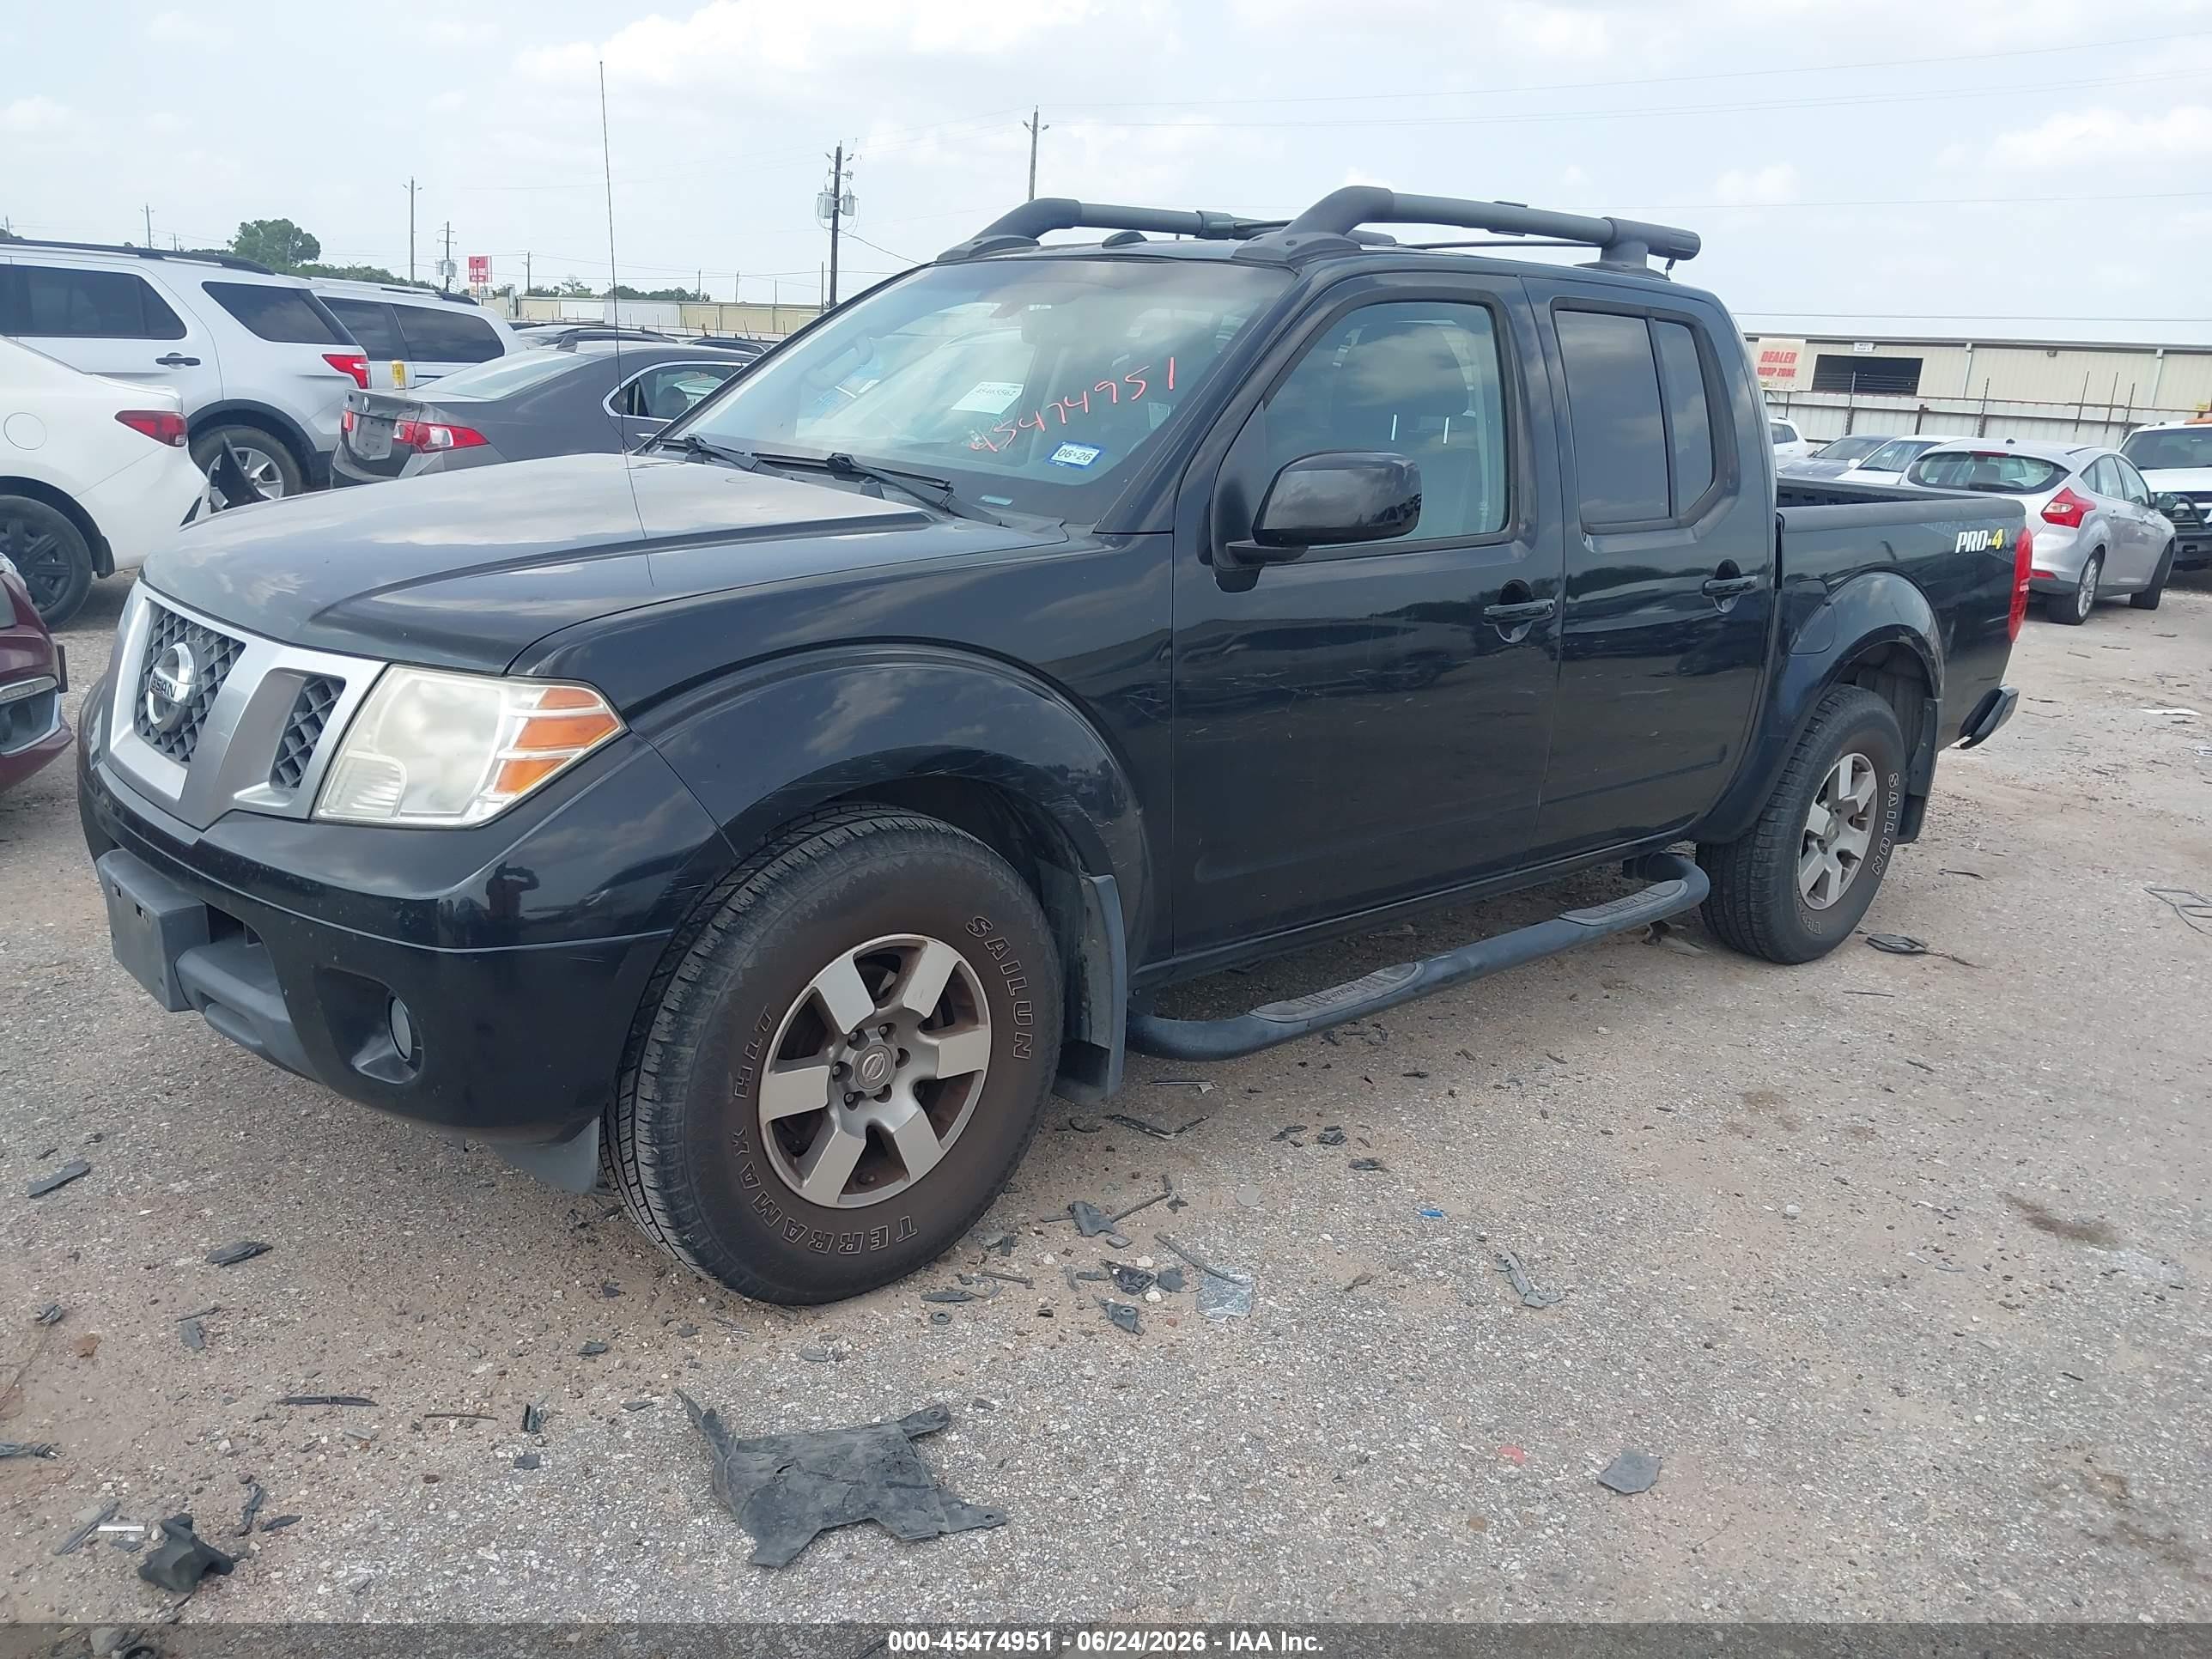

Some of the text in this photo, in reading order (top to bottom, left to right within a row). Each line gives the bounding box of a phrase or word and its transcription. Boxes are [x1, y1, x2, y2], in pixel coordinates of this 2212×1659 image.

[1760, 351, 1797, 364] DEALER
[1872, 772, 1899, 876] SAILUN
[965, 915, 1034, 1060] SAILUN
[733, 1126, 919, 1255] TERRAMAX
